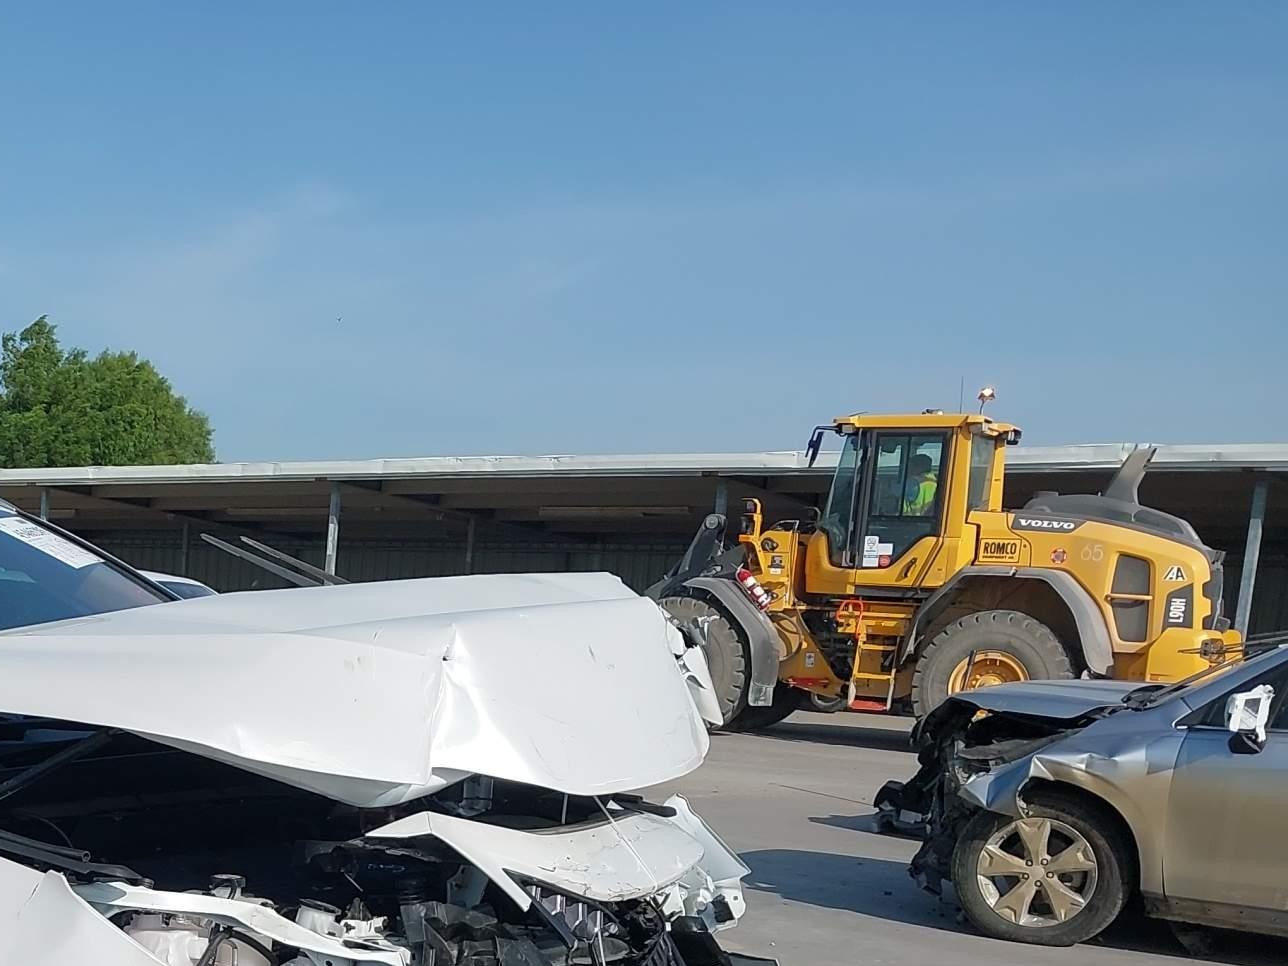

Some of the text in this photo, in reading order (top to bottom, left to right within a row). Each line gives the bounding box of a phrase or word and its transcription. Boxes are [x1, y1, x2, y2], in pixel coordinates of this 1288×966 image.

[1018, 518, 1075, 530] VOLVO
[982, 542, 1018, 556] ROMCO
[1167, 597, 1187, 623] L90H
